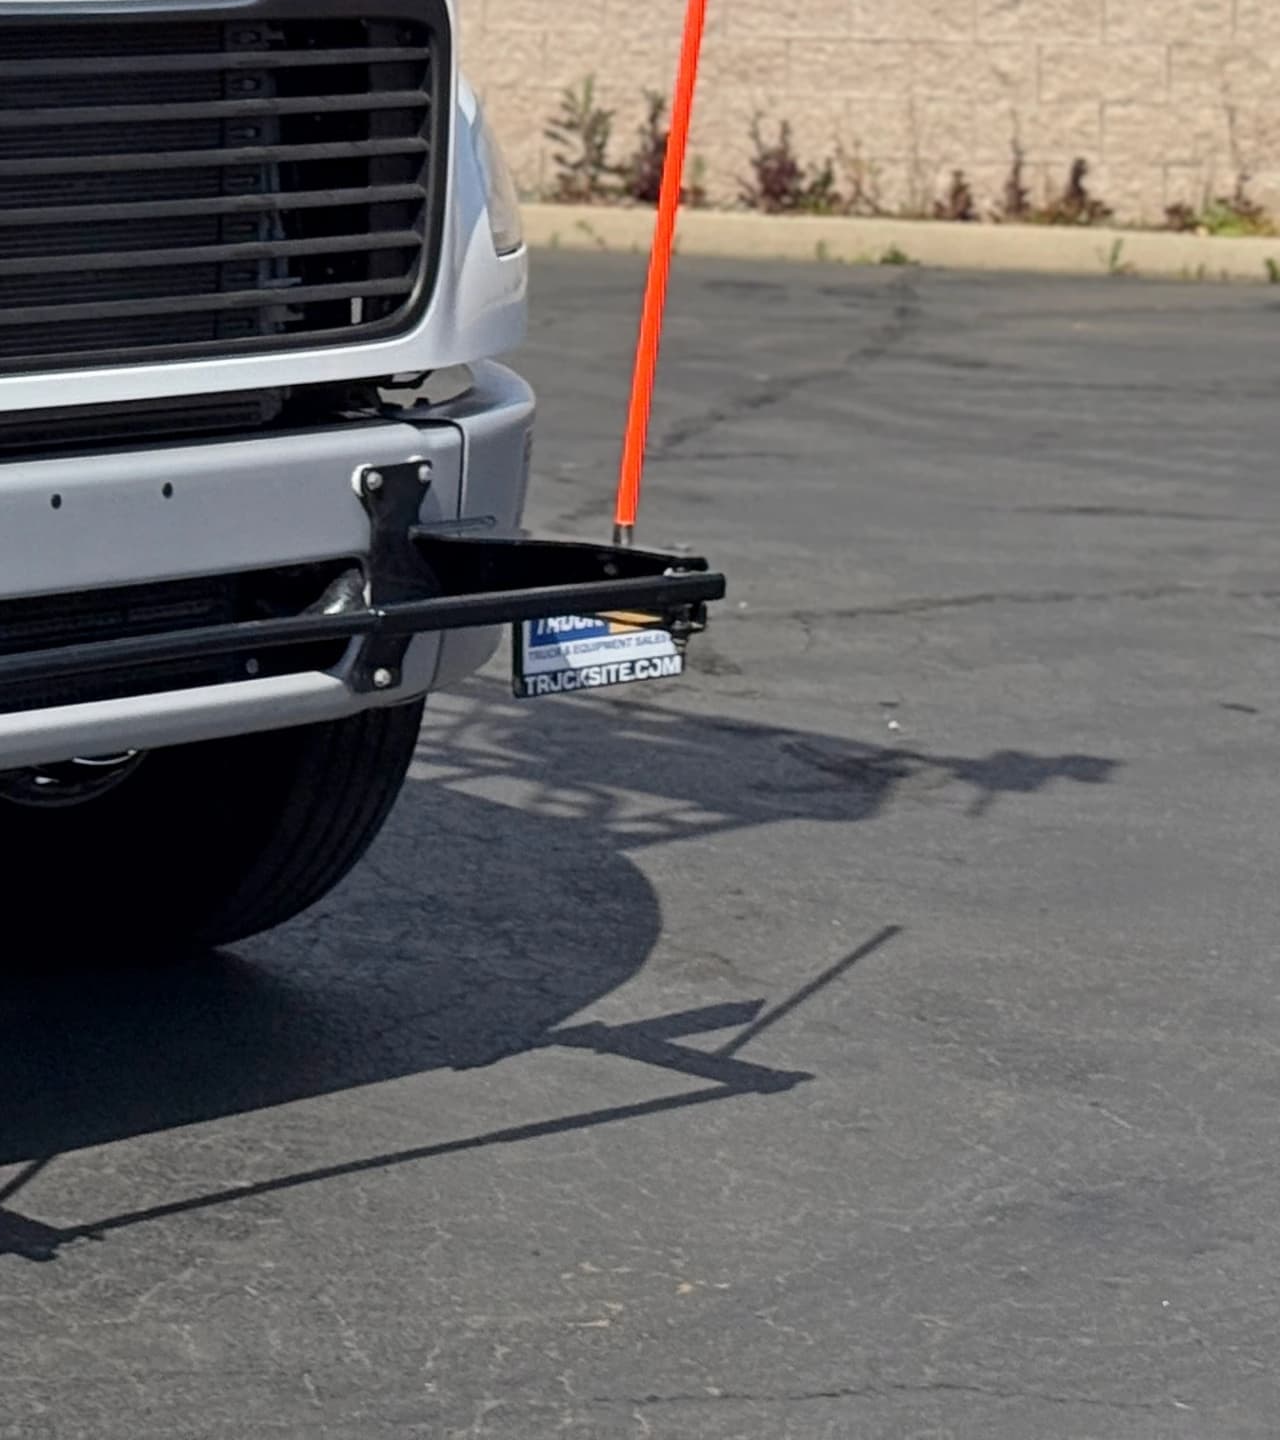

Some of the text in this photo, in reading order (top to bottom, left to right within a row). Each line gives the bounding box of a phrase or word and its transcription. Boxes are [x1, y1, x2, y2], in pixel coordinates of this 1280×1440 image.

[573, 636, 634, 655] EQUIPMENT
[636, 632, 668, 648] SALES
[524, 655, 682, 696] TRUCKSITE.COM
